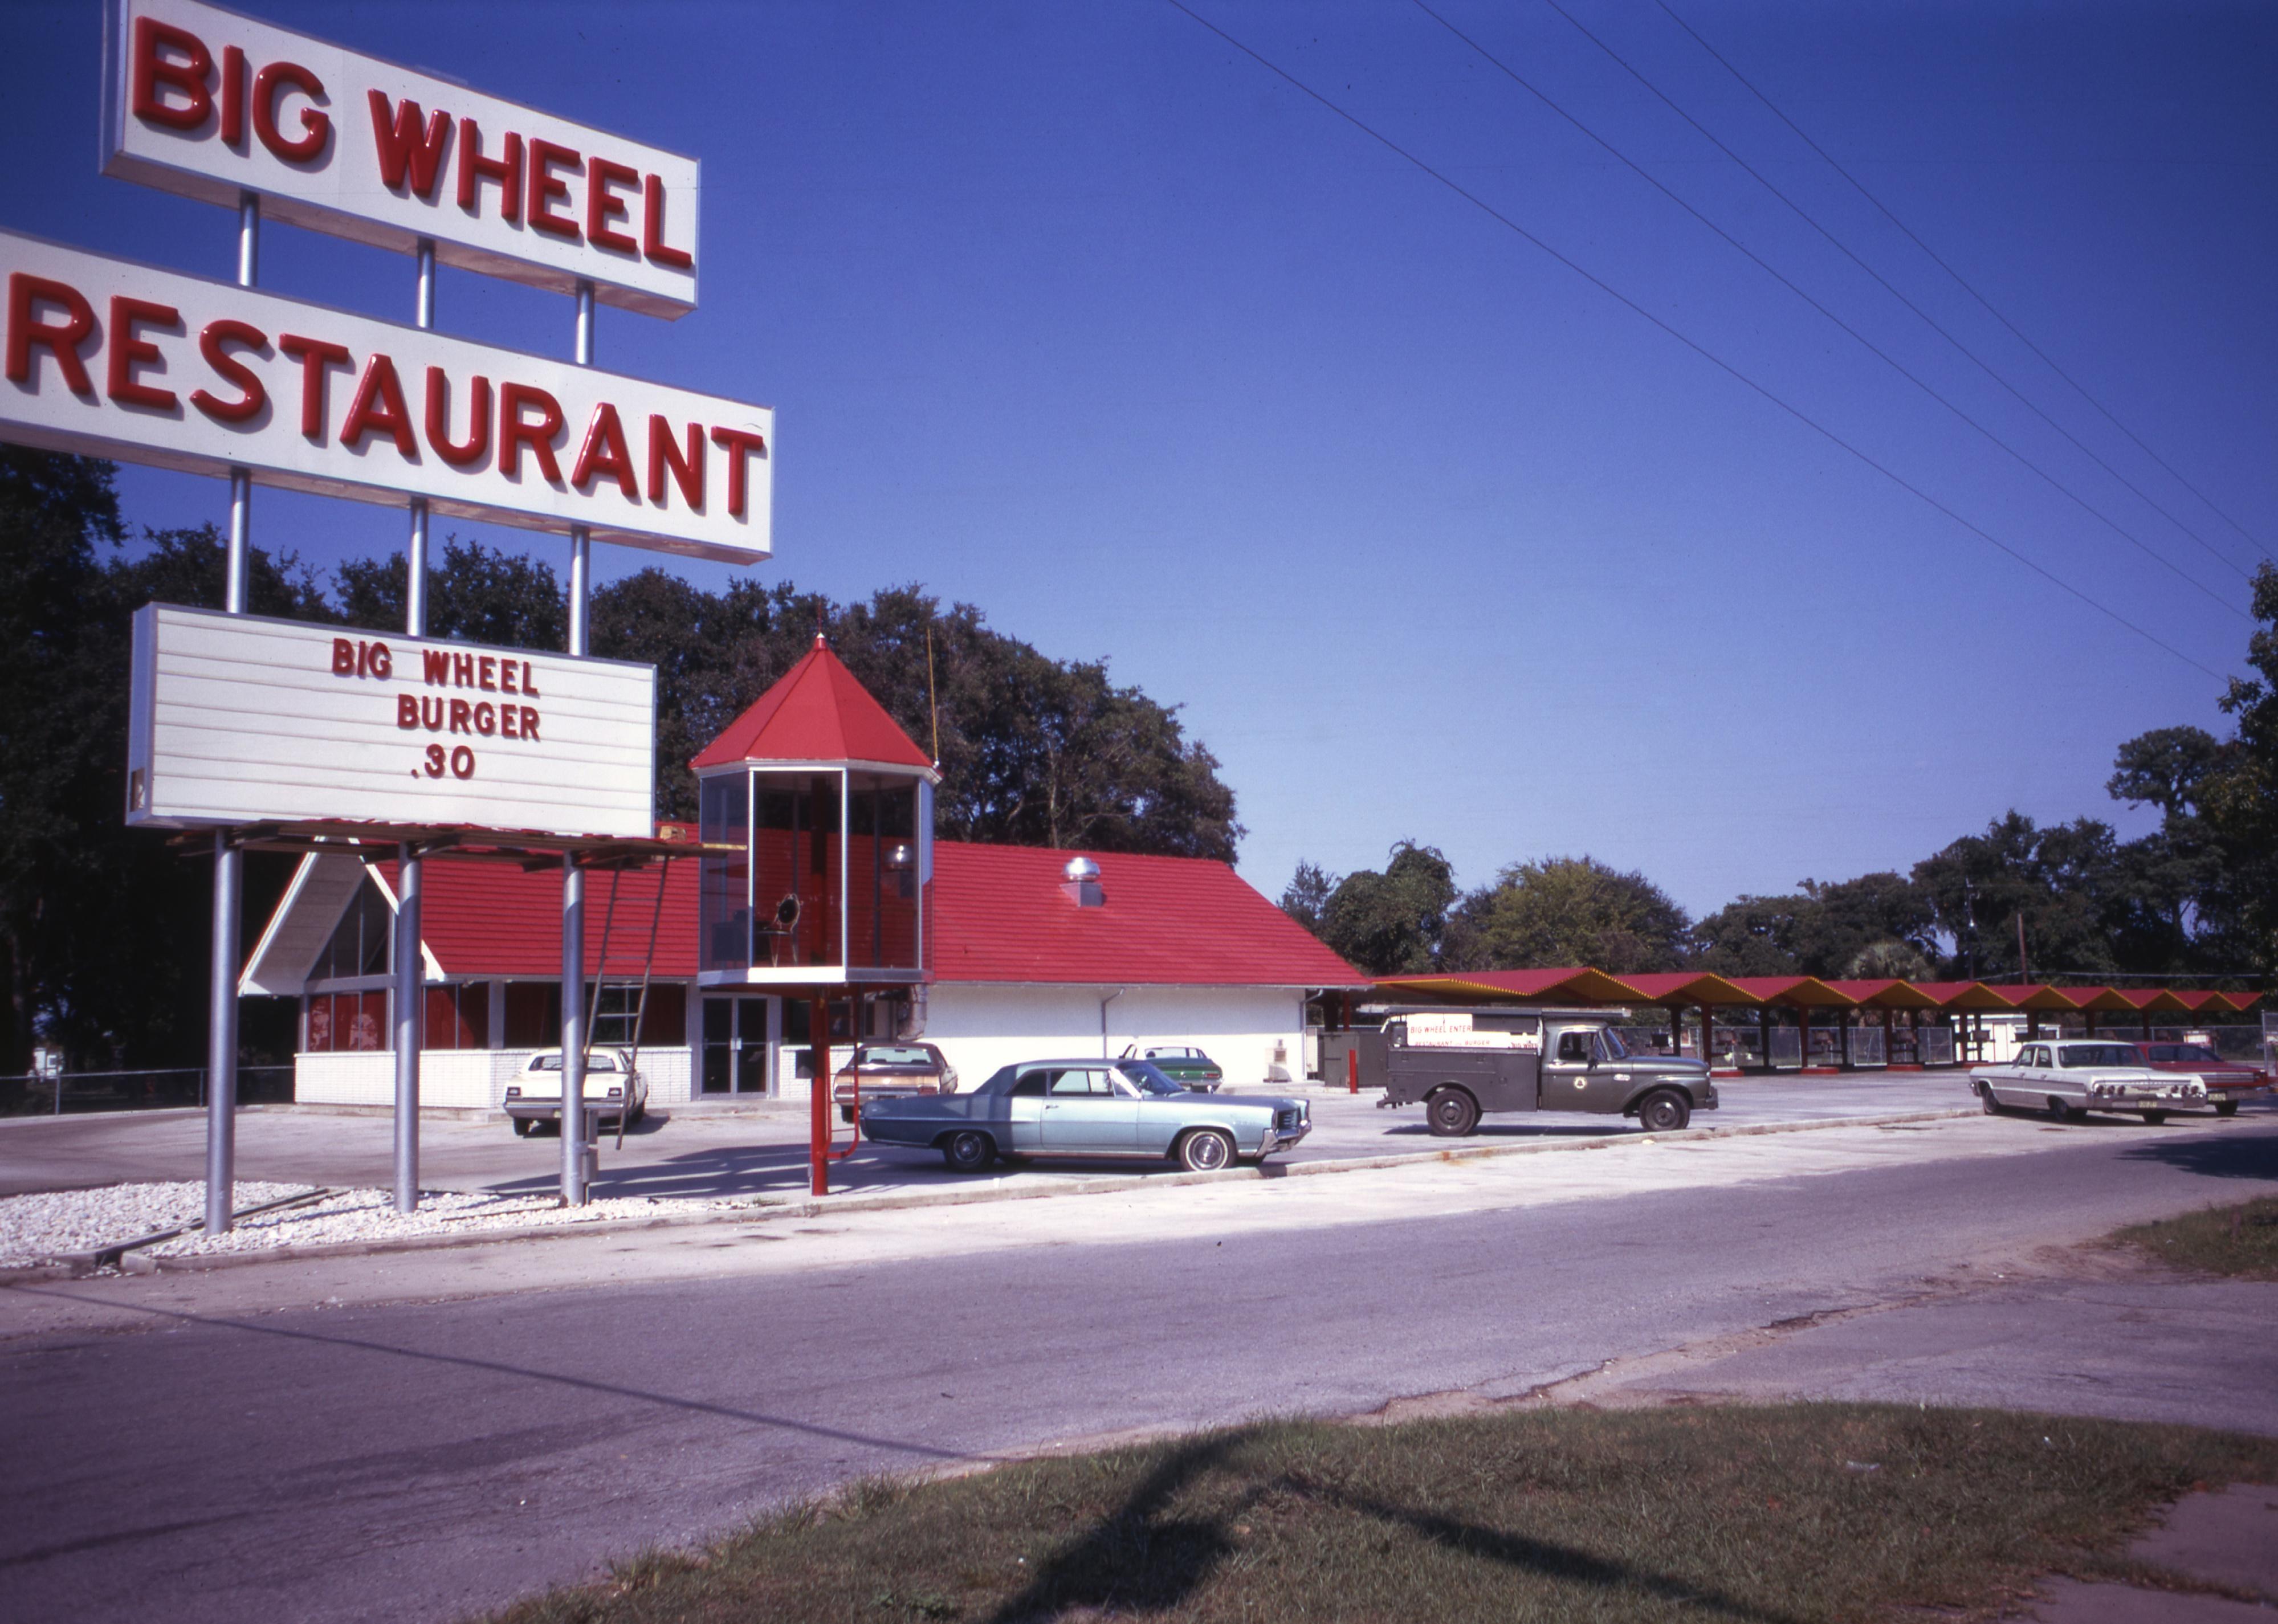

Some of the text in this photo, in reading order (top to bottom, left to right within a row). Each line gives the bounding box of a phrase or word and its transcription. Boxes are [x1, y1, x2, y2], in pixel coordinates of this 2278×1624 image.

[133, 16, 692, 269] BIG WHEEL
[6, 272, 764, 516] RESTAURANT
[332, 638, 539, 695] BIG WHEEL
[398, 695, 539, 740] BURGER
[411, 744, 474, 779] .30
